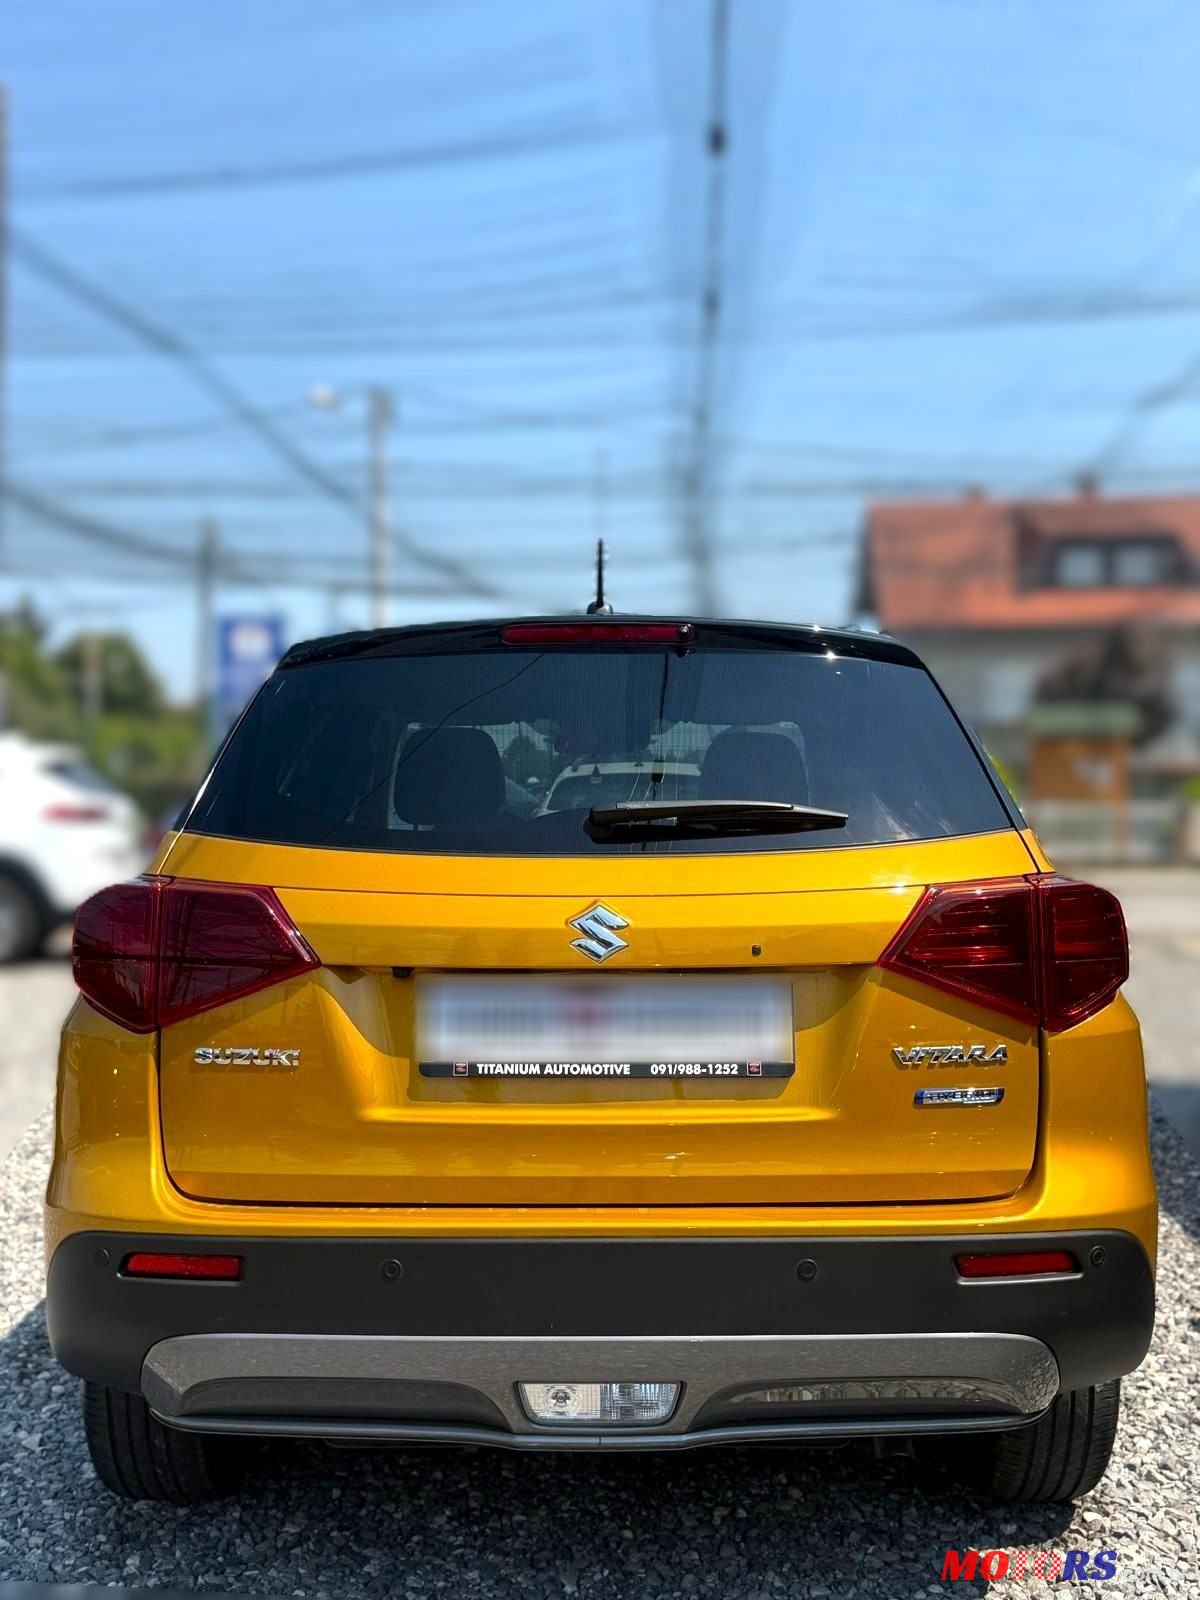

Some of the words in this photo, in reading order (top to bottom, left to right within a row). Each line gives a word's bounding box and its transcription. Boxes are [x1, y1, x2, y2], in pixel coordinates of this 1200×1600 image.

[194, 1047, 300, 1066] SUZUKI
[892, 1044, 1008, 1065] VITARA
[477, 1063, 541, 1076] TITANIUM
[544, 1063, 631, 1076] AUTOMOTIVE
[650, 1063, 739, 1076] 091/988-1252
